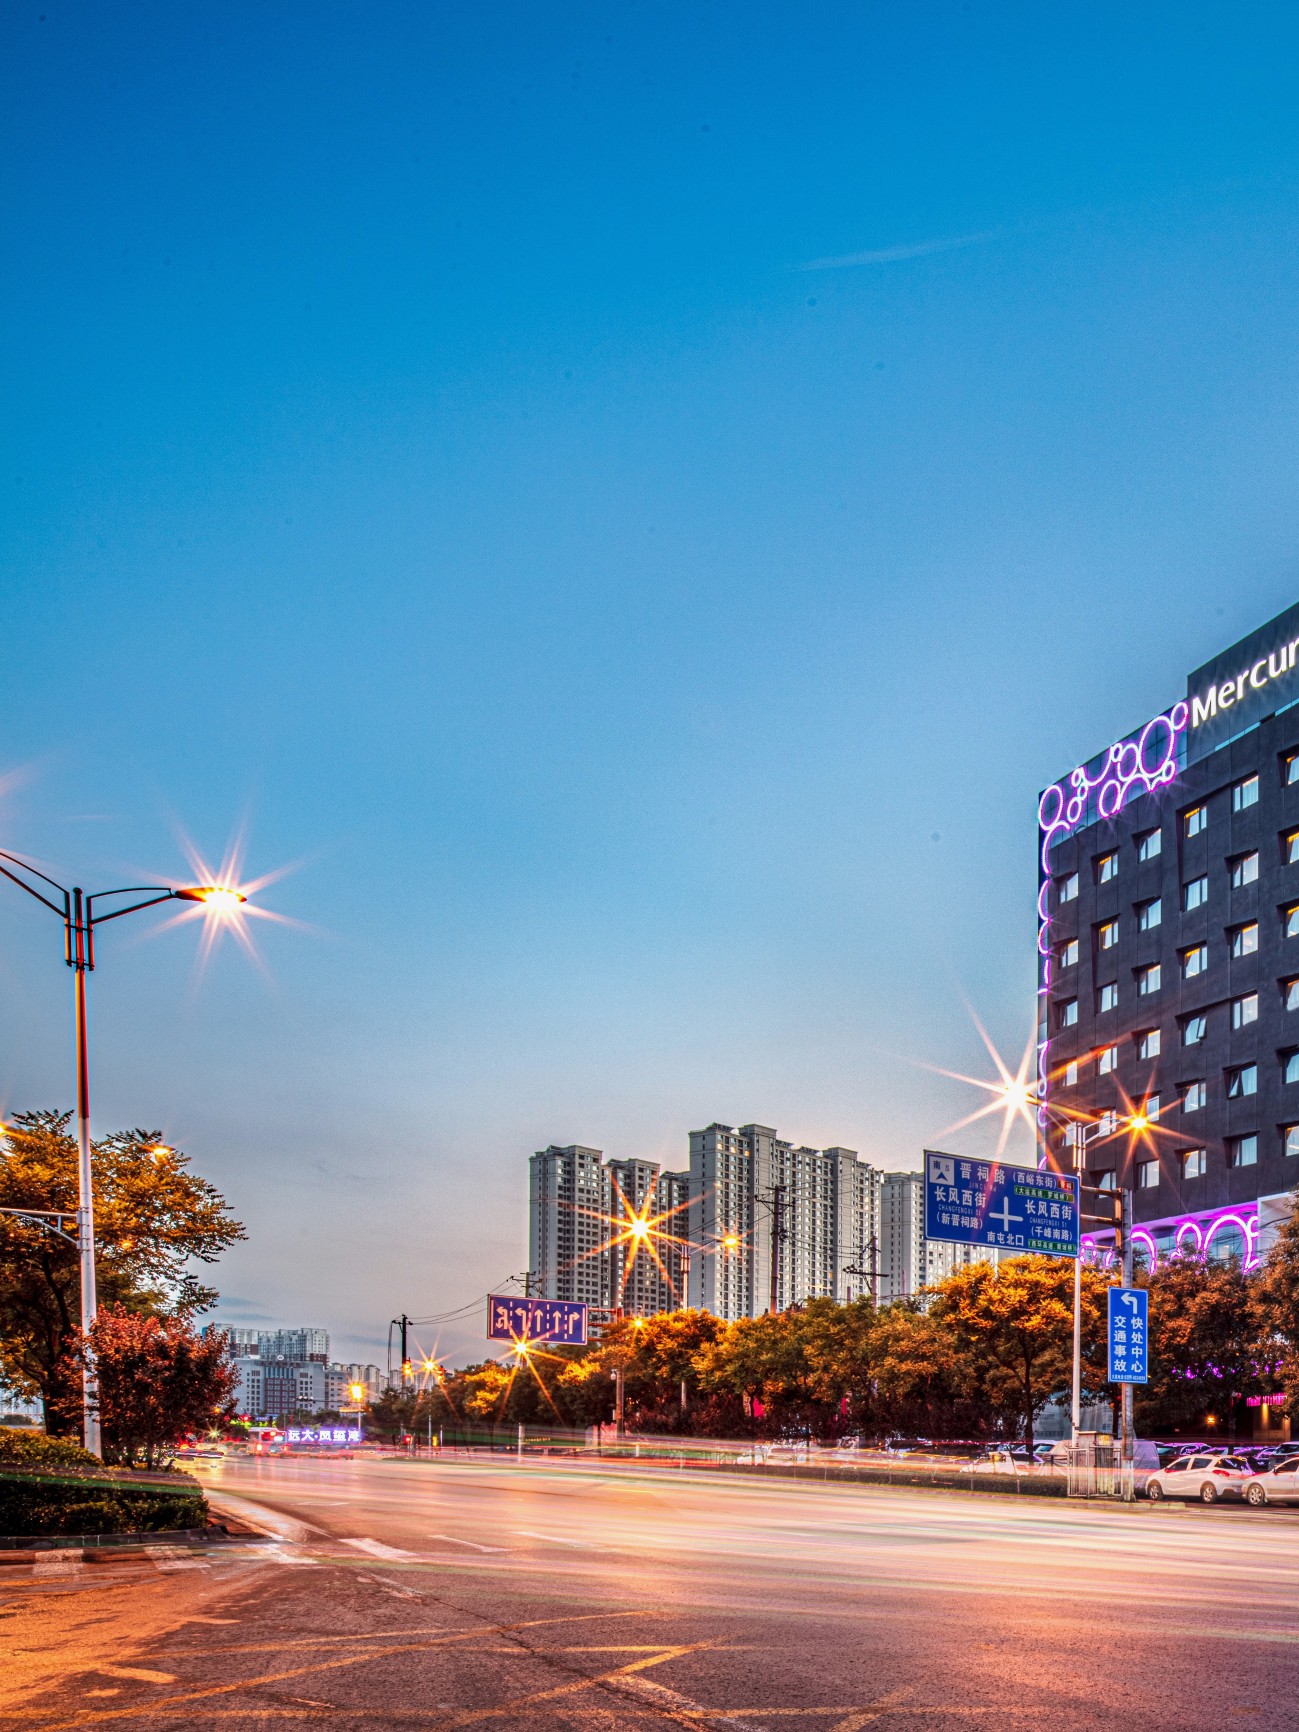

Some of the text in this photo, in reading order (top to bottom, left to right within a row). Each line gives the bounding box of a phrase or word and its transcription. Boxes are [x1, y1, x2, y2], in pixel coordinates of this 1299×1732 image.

[932, 1160, 950, 1172] 南 S
[960, 1162, 1005, 1185] 晋祠路
[934, 1186, 986, 1208] 长风西街
[1025, 1199, 1073, 1220] 长风西街
[987, 1231, 1024, 1247] 南屯北口
[1113, 1315, 1127, 1372] 交通事故
[1130, 1316, 1144, 1373] 快处中心
